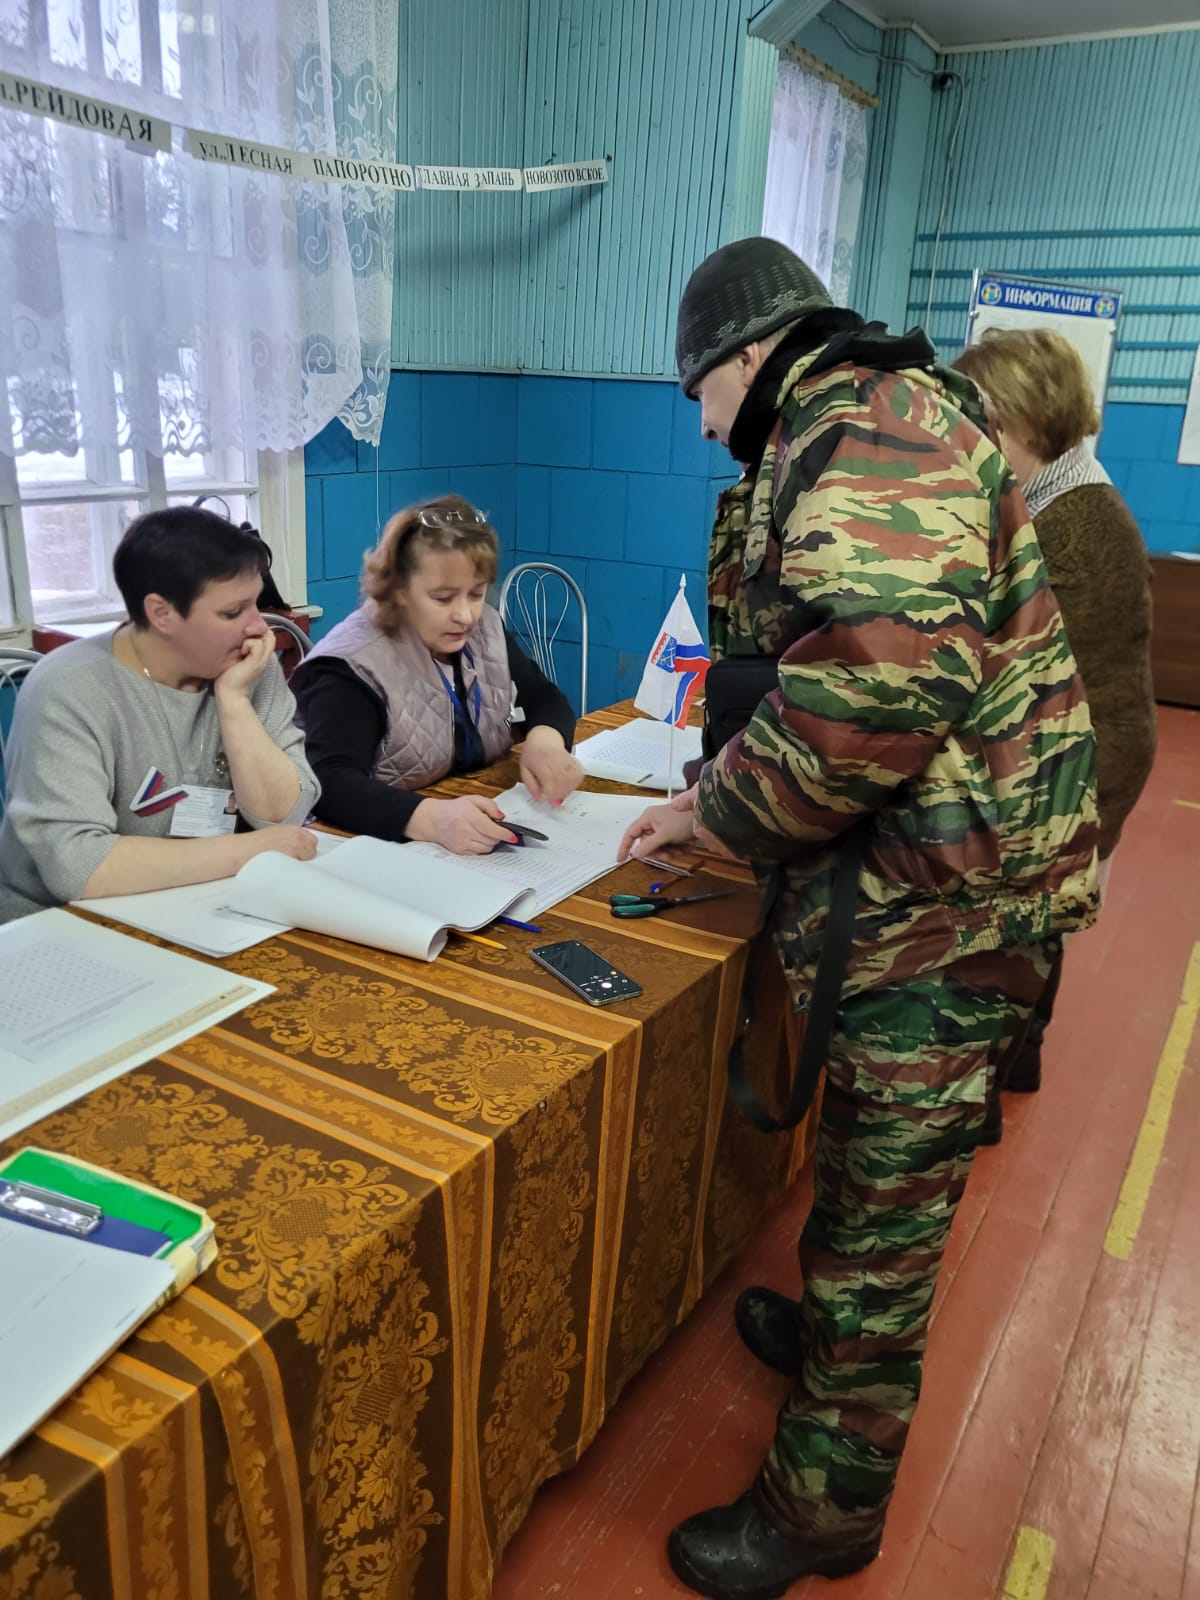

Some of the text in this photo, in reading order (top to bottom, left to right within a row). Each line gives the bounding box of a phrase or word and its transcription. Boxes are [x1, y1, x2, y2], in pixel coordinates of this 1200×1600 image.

[0, 80, 152, 142] .РЕЙДОВАЯ
[313, 158, 411, 188] ПАПОРОТНО
[474, 171, 514, 187] ЗАПАНЬ
[1004, 287, 1093, 312] ИНФОРМАЦИЯ
